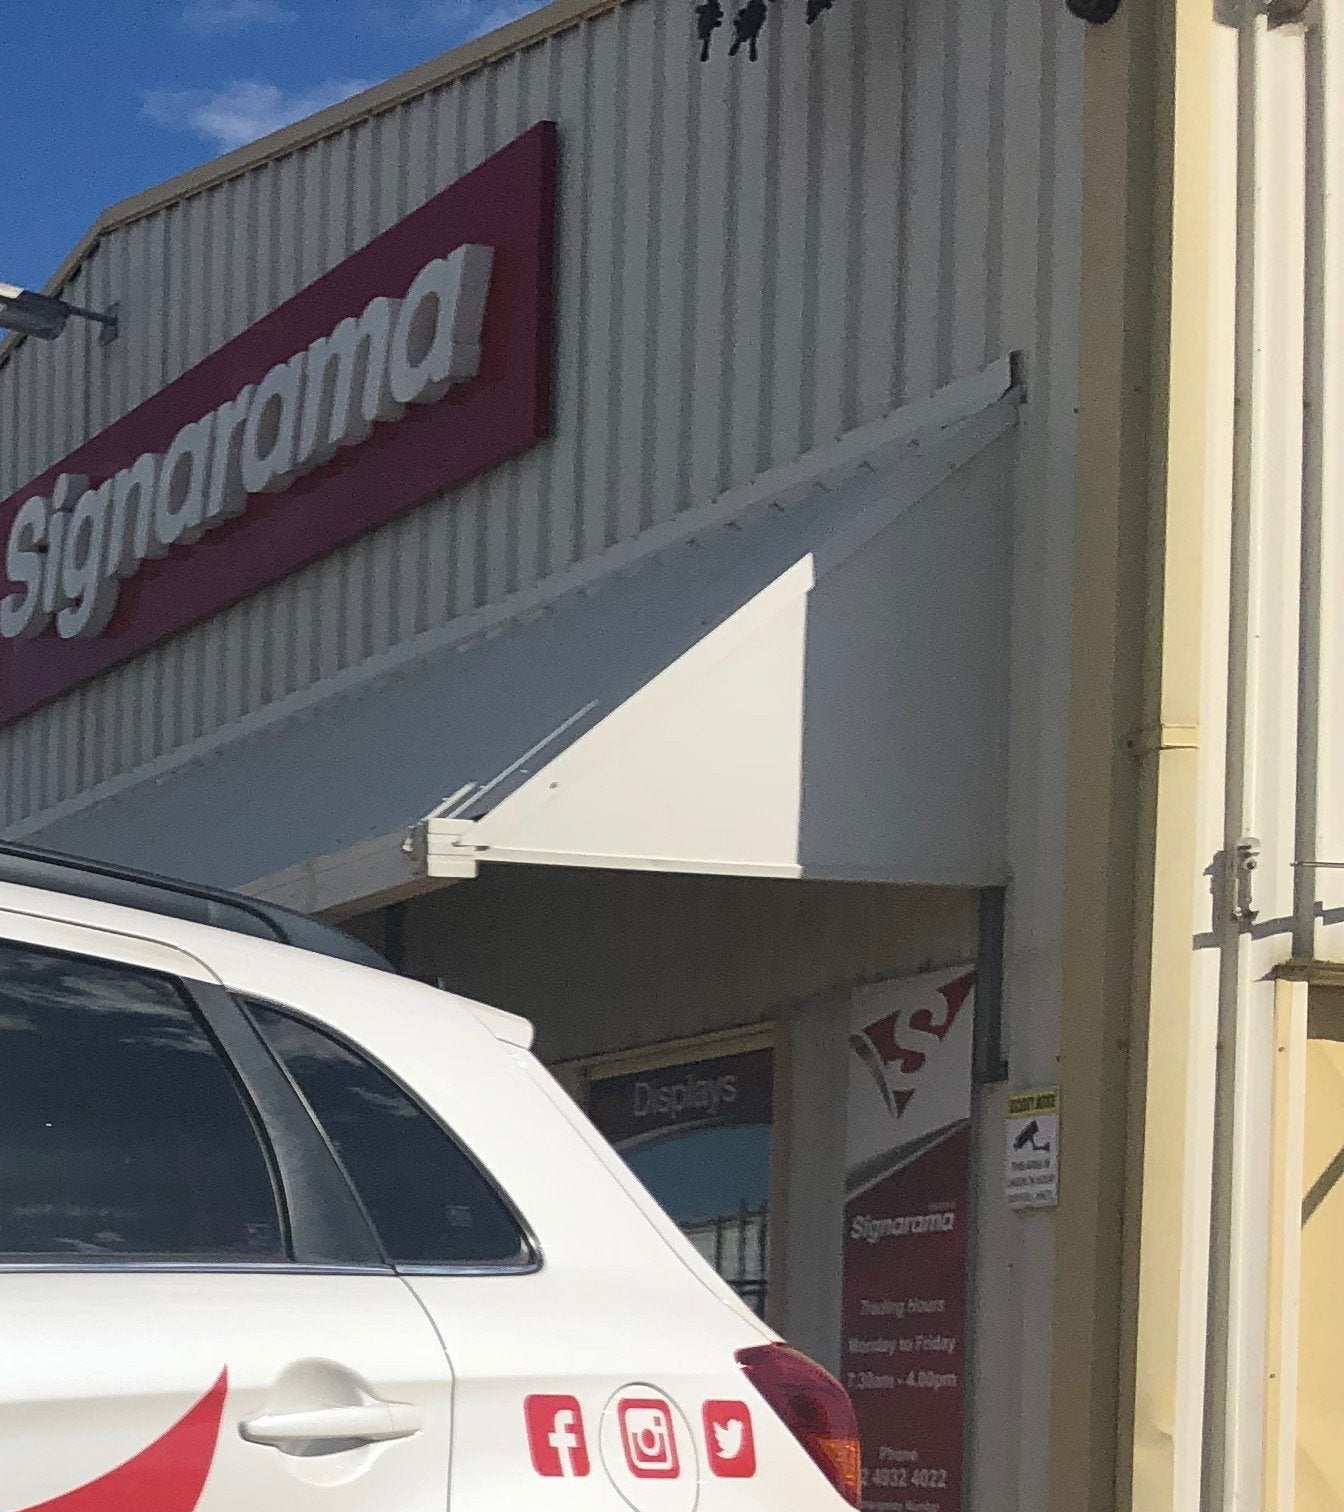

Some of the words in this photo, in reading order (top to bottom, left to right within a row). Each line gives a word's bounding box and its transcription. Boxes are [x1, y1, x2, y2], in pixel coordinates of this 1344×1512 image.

[633, 1074, 737, 1119] Displays
[850, 1213, 955, 1244] Signarama
[848, 1338, 898, 1357] Monday
[899, 1339, 913, 1351] to
[914, 1334, 957, 1354] Friday
[911, 1468, 947, 1488] 4022
